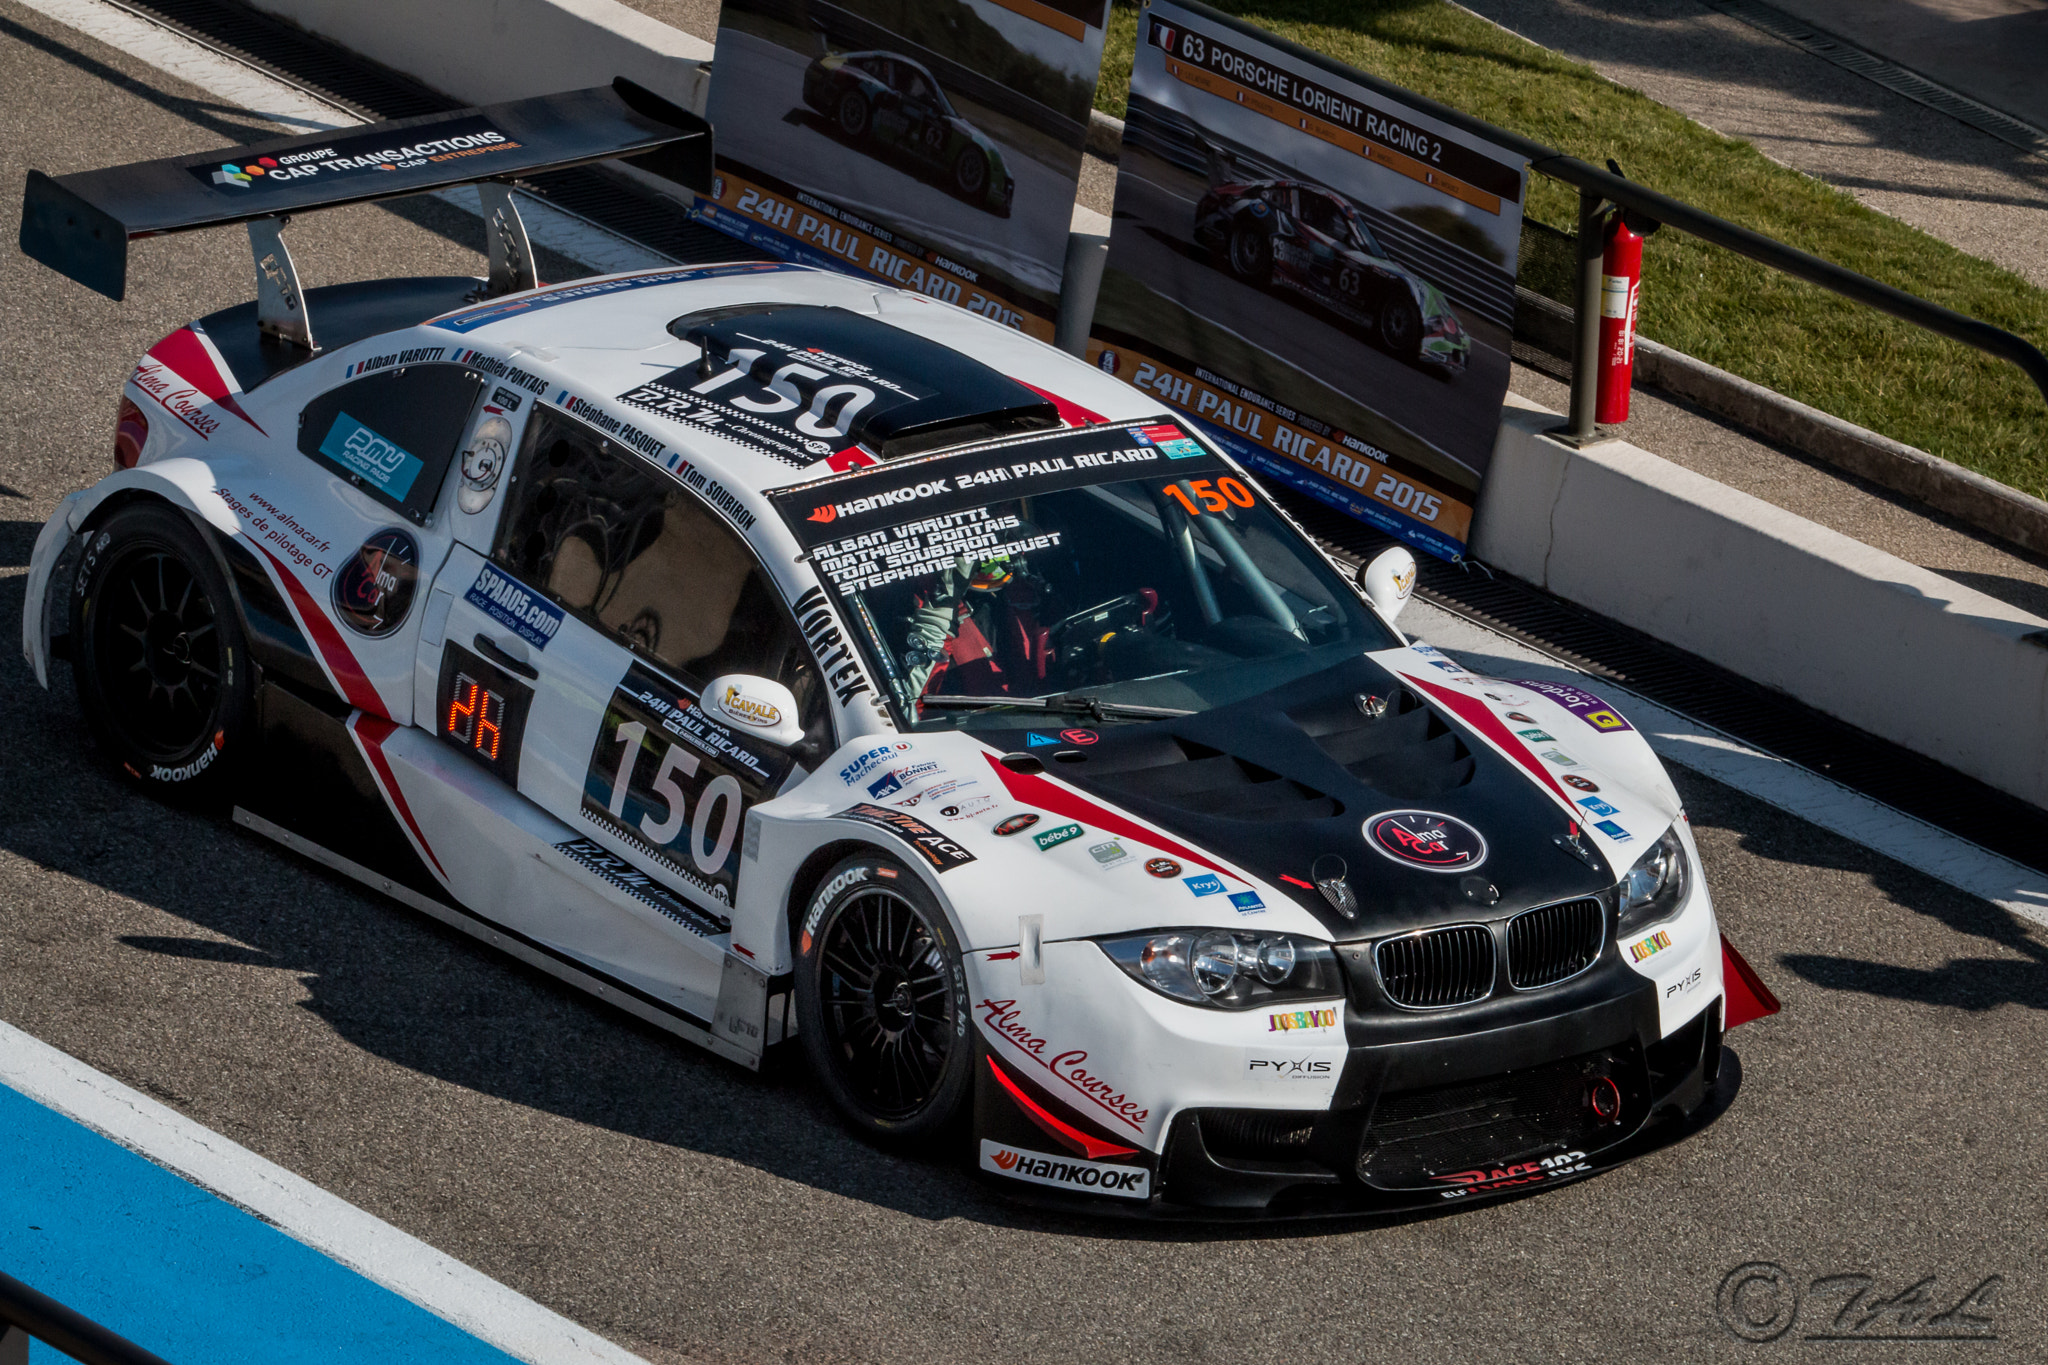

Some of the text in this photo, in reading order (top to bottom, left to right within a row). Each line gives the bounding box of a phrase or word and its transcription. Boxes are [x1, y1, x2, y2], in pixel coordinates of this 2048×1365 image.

[1182, 34, 1205, 63] 63
[1211, 46, 1288, 97] PORSCHE
[1292, 81, 1363, 127] LORIENT
[1366, 113, 1428, 157] RACING
[1431, 142, 1442, 163] 2
[268, 131, 507, 181] CAP TRANSACTIONS
[279, 147, 338, 165] GROUPE
[395, 141, 523, 169] CAP ENTREPRISE
[796, 191, 838, 219] INTERNATIONAL
[839, 209, 872, 233] ENDURANCE
[873, 223, 893, 243] SERIES
[735, 187, 794, 230] 24H
[796, 214, 860, 262] PAUL
[869, 246, 961, 305] RICARD
[965, 292, 1024, 332] 2015
[1339, 268, 1360, 296] 63
[364, 347, 446, 372] Alban VARUTTI
[467, 350, 509, 377] Mathieu
[505, 366, 550, 396] PONTAIS
[796, 351, 837, 367] PAUL
[838, 365, 904, 391] RICARD
[130, 364, 221, 437] Alma Courses
[690, 348, 876, 437] 150
[1195, 367, 1239, 397] INTERNATIONAL
[1240, 386, 1275, 412] ENDURANCE
[1275, 400, 1296, 422] SERIES
[572, 397, 667, 459] Stéphane PASQUET
[1133, 362, 1193, 405] 24H
[1197, 391, 1264, 441] PAUL
[1272, 424, 1371, 489] RICARD
[1374, 472, 1443, 522] 2015
[342, 450, 371, 470] RACING
[370, 468, 391, 483] PADS
[955, 467, 1005, 490] 24H
[1012, 458, 1075, 480] PAUL
[1076, 447, 1158, 470] RICARD
[682, 463, 757, 532] Tom SOUBIRON
[1162, 475, 1255, 516] 150
[217, 487, 334, 580] Stages de pilotage GT
[249, 492, 331, 554] www.almacar.fr
[813, 506, 991, 561] ALBAN VARUTTI
[821, 514, 1021, 573] MATHIEU PONTAIS
[827, 532, 998, 583] TOM SOUBIRON
[839, 532, 1062, 596] STEPHANE PASQUET
[469, 592, 545, 646] RACE POSITION DISPLAY
[792, 585, 870, 709] VORTEK
[637, 691, 673, 713] 24H
[668, 708, 703, 737] PAUL
[705, 729, 760, 771] RICARD
[839, 746, 891, 780] SUPER
[846, 752, 898, 787] Machecoul
[899, 764, 938, 780] BONNET
[608, 720, 742, 875] 150
[875, 784, 898, 800] AXA
[901, 796, 920, 807] AD
[916, 836, 970, 861] ACE
[997, 814, 1038, 836] MJC
[1039, 826, 1077, 847] bébé 9
[1192, 879, 1217, 891] Krys
[1629, 930, 1672, 963] JOOSBAYOO
[1667, 968, 1701, 998] PYXIS
[1268, 1009, 1335, 1032] JOOSBAYOO
[976, 999, 1148, 1130] Alma Courses
[1249, 1054, 1332, 1077] PYXIS
[1429, 1150, 1593, 1198] ELF RACE 102
